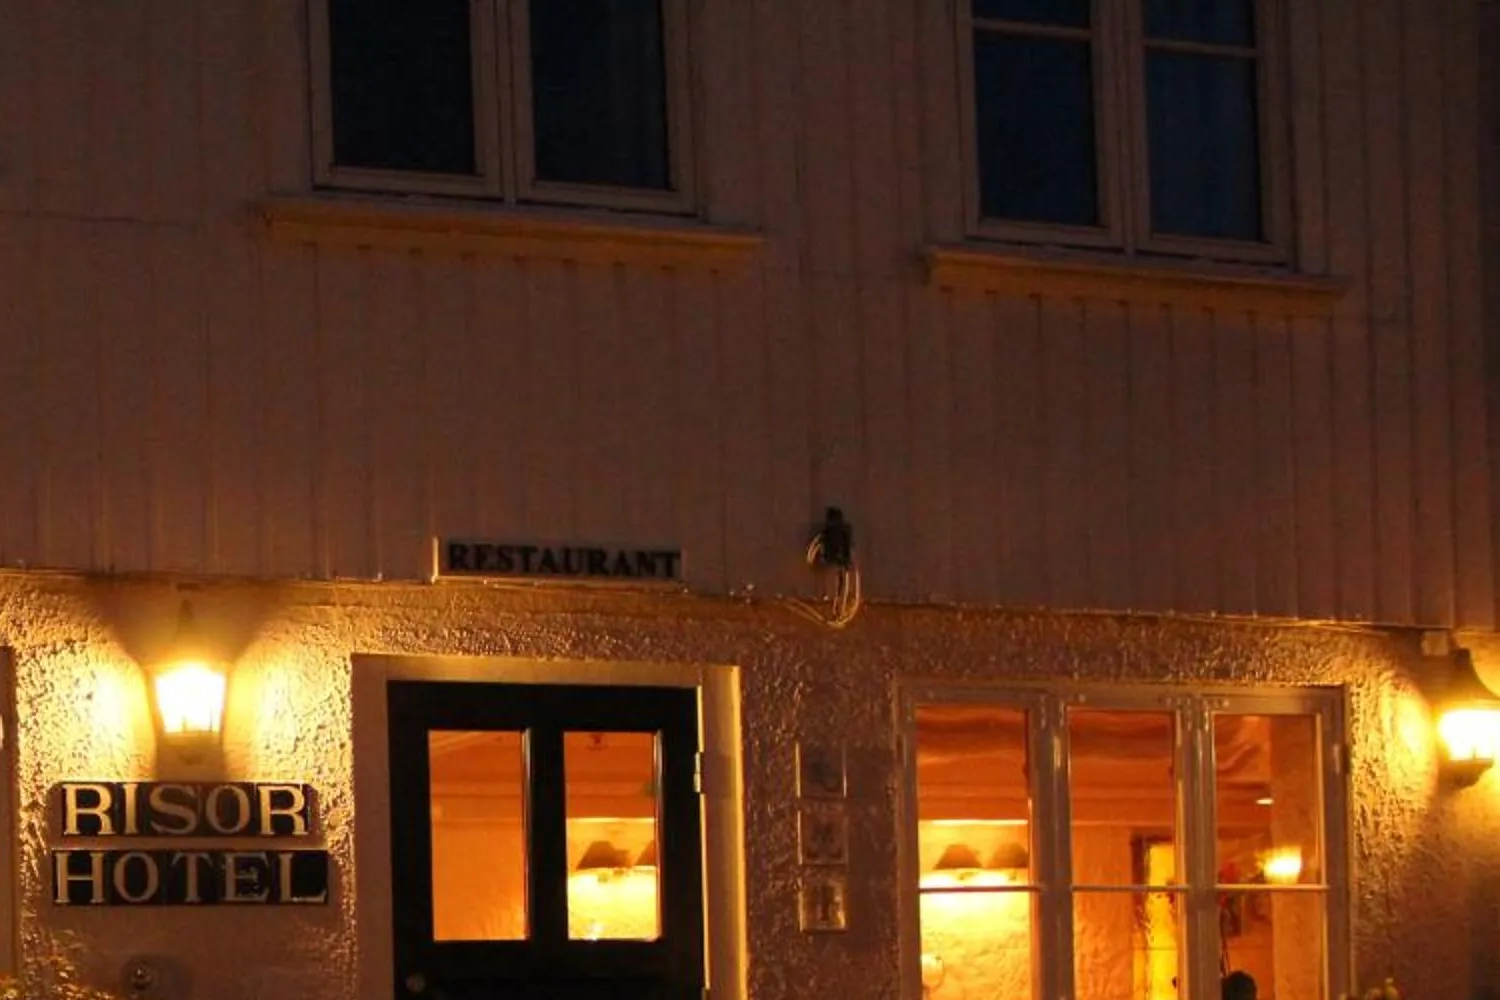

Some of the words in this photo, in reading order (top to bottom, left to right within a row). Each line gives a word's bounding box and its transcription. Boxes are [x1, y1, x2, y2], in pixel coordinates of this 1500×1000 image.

[449, 543, 680, 577] RESTAURANT
[61, 783, 309, 836] RISOR
[54, 851, 328, 904] HOTEL
